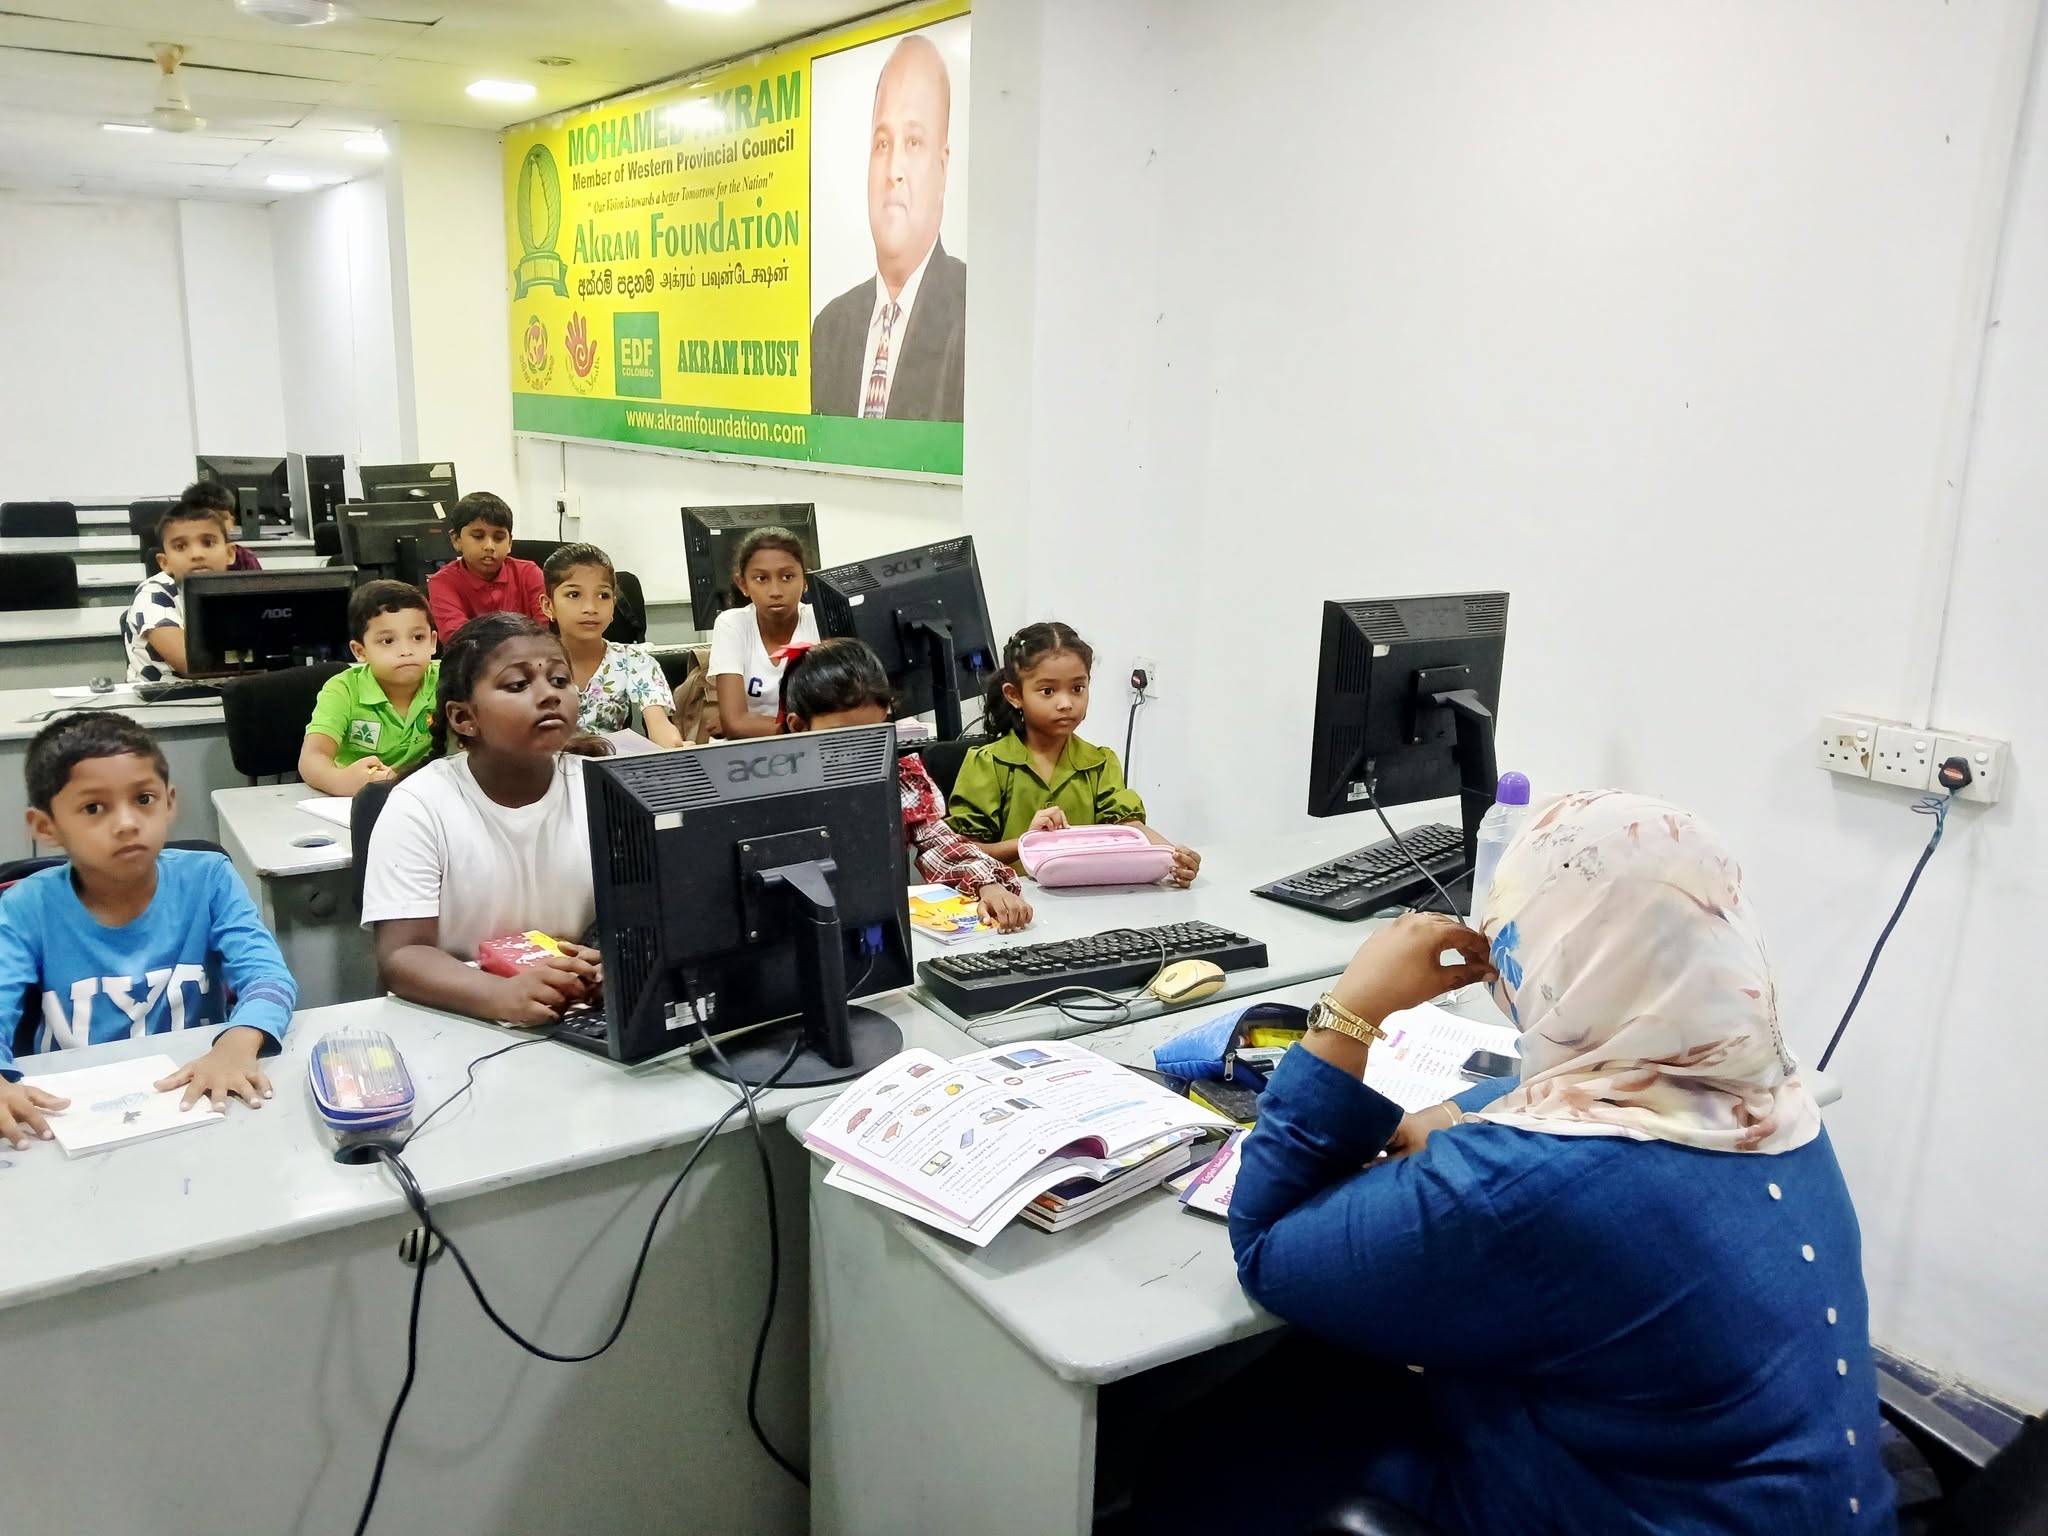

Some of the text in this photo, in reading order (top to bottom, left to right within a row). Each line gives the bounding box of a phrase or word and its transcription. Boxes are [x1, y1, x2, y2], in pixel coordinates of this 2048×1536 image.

[694, 71, 800, 139] KRAM
[572, 128, 794, 191] Member of Western Provincial Council
[631, 192, 654, 208] towards
[682, 186, 715, 201] Tomorrow
[716, 181, 727, 200] for
[729, 178, 740, 193] the
[620, 338, 653, 366] EDF
[677, 340, 799, 376] AKRAM TRUST
[622, 367, 654, 378] COLOMBO
[625, 408, 806, 444] www.akramfoundation.com
[261, 607, 293, 619] AOC
[727, 752, 806, 783] acer
[40, 963, 209, 1054] NYC
